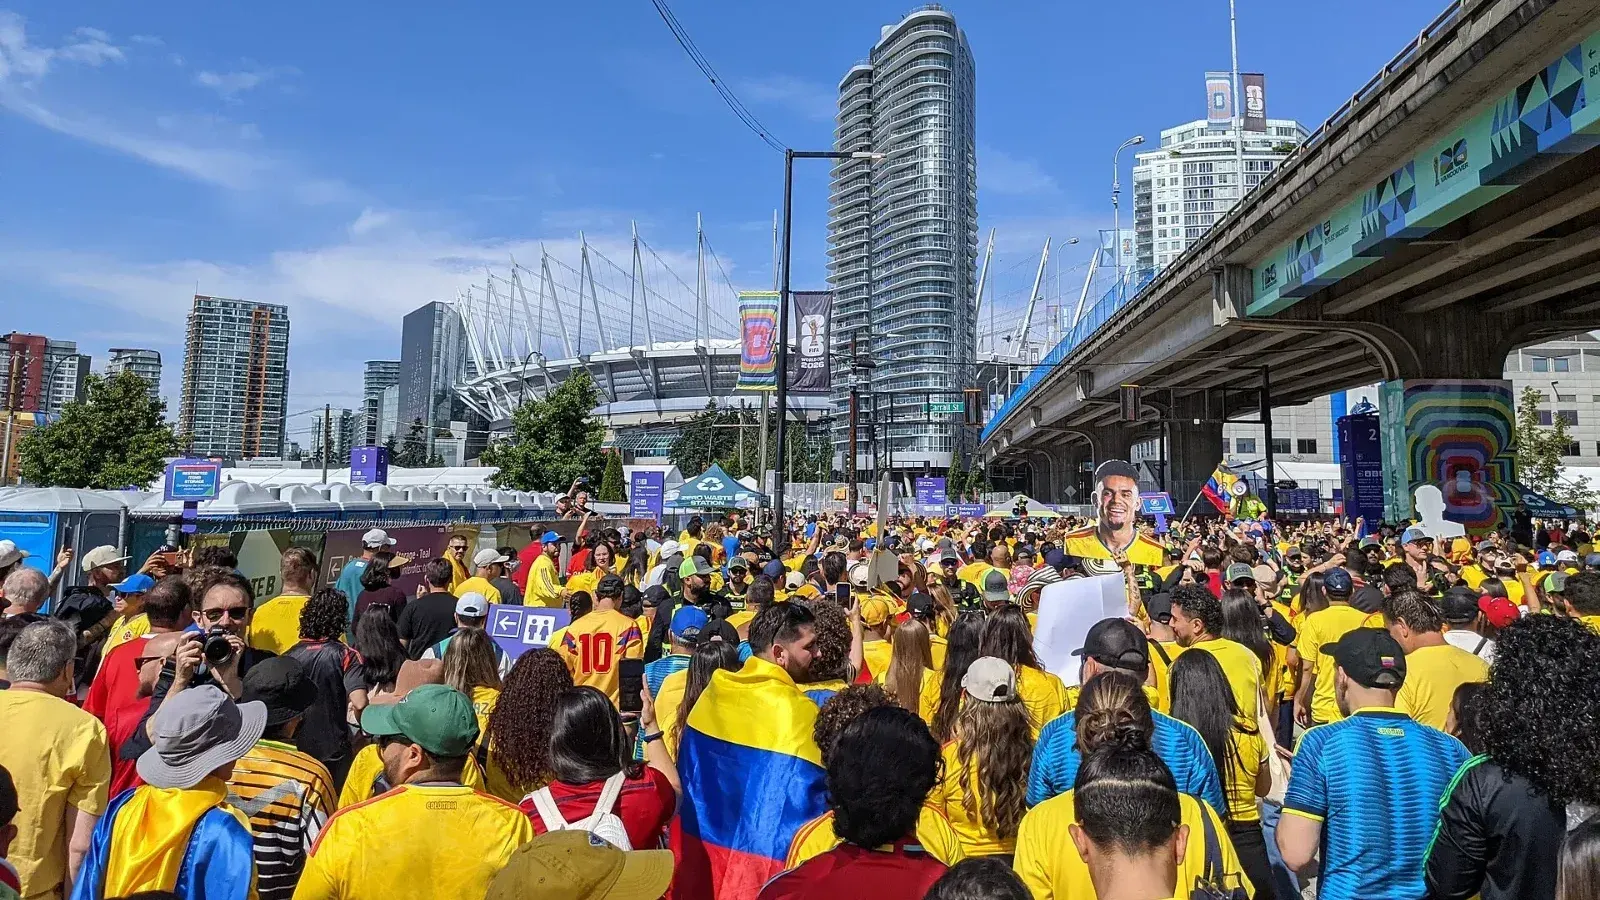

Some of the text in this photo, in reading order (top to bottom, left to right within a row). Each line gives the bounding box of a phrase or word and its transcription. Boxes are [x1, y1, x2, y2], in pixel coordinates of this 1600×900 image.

[801, 361, 825, 369] 2026
[1368, 428, 1377, 441] 2
[361, 454, 367, 463] 3
[419, 547, 431, 559] Teal
[250, 575, 276, 598] TE B
[578, 632, 613, 675] 10
